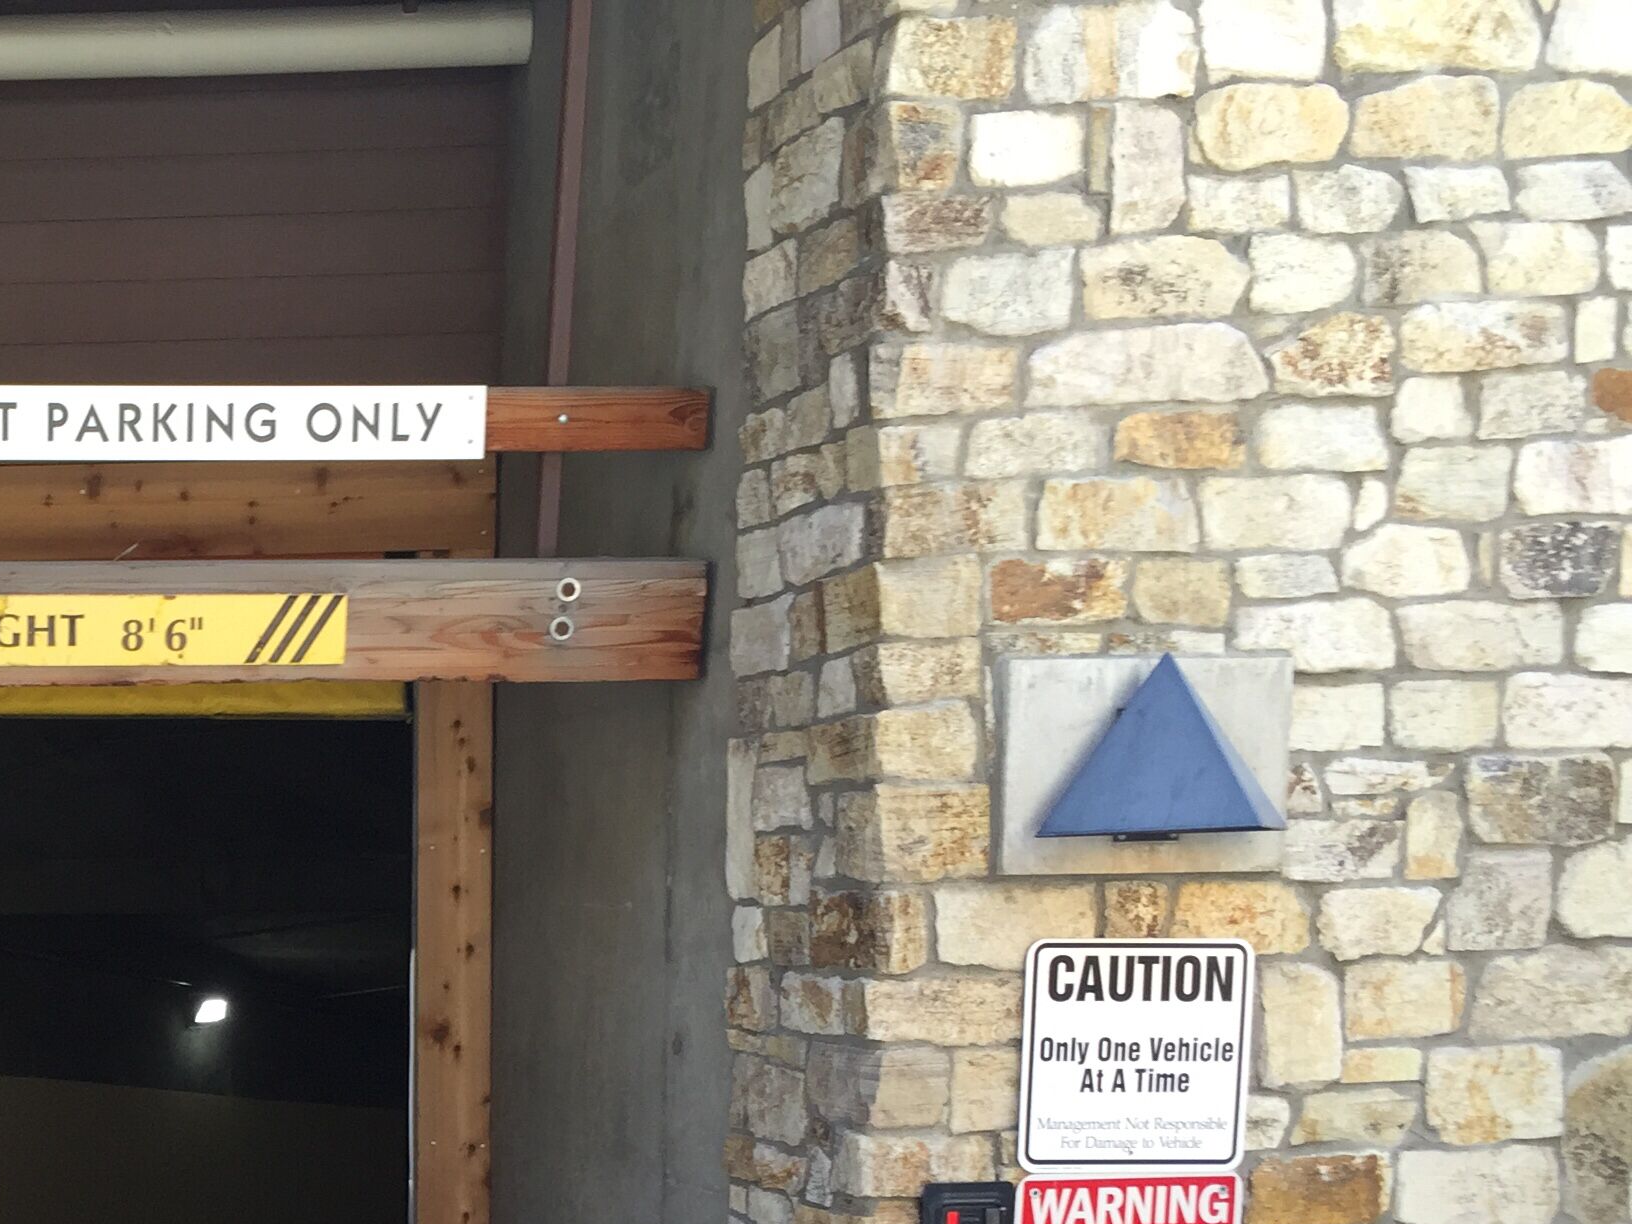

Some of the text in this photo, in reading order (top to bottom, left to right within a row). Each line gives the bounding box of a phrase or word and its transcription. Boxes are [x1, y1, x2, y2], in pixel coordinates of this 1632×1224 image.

[47, 402, 277, 443] PARKING
[306, 402, 443, 443] ONLY
[1048, 955, 1235, 1002] CAUTION
[1040, 1037, 1234, 1065] Only One Vehicle
[1079, 1068, 1190, 1093] At A Time
[1037, 1117, 1228, 1134] Management Not Responsible
[1060, 1136, 1202, 1153] For Damage to Vehicle
